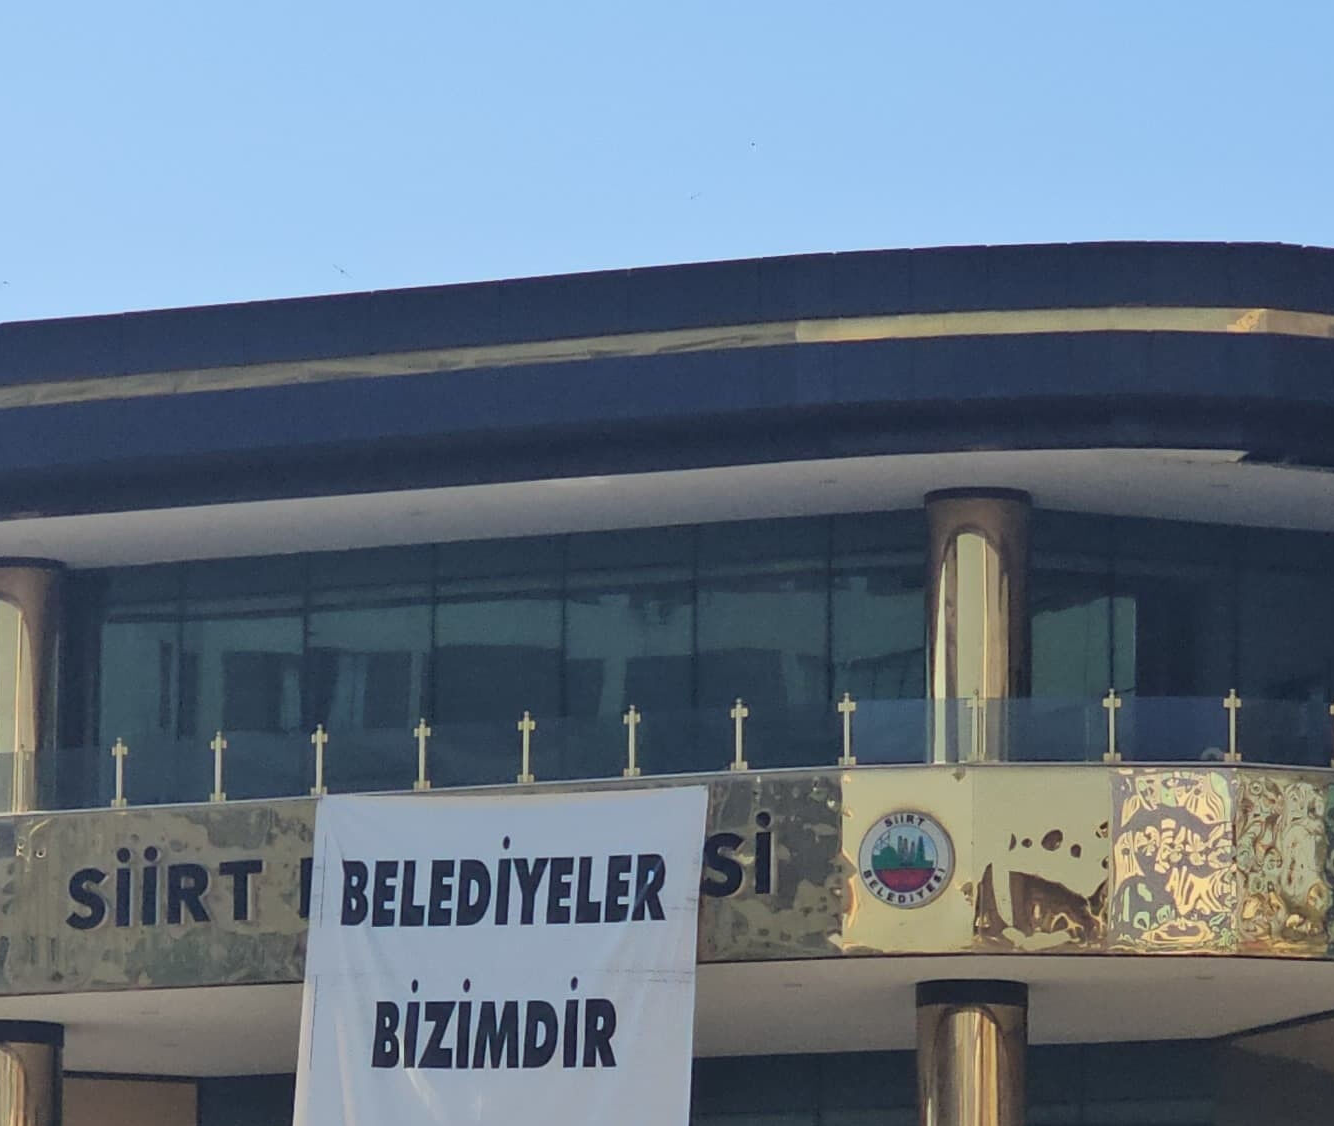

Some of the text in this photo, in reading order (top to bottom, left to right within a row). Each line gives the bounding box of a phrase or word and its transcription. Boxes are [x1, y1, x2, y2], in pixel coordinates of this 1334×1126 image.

[65, 845, 264, 930] SİİRT
[340, 835, 667, 928] BELEDİYELER
[371, 975, 617, 1070] BİZİMDİR
